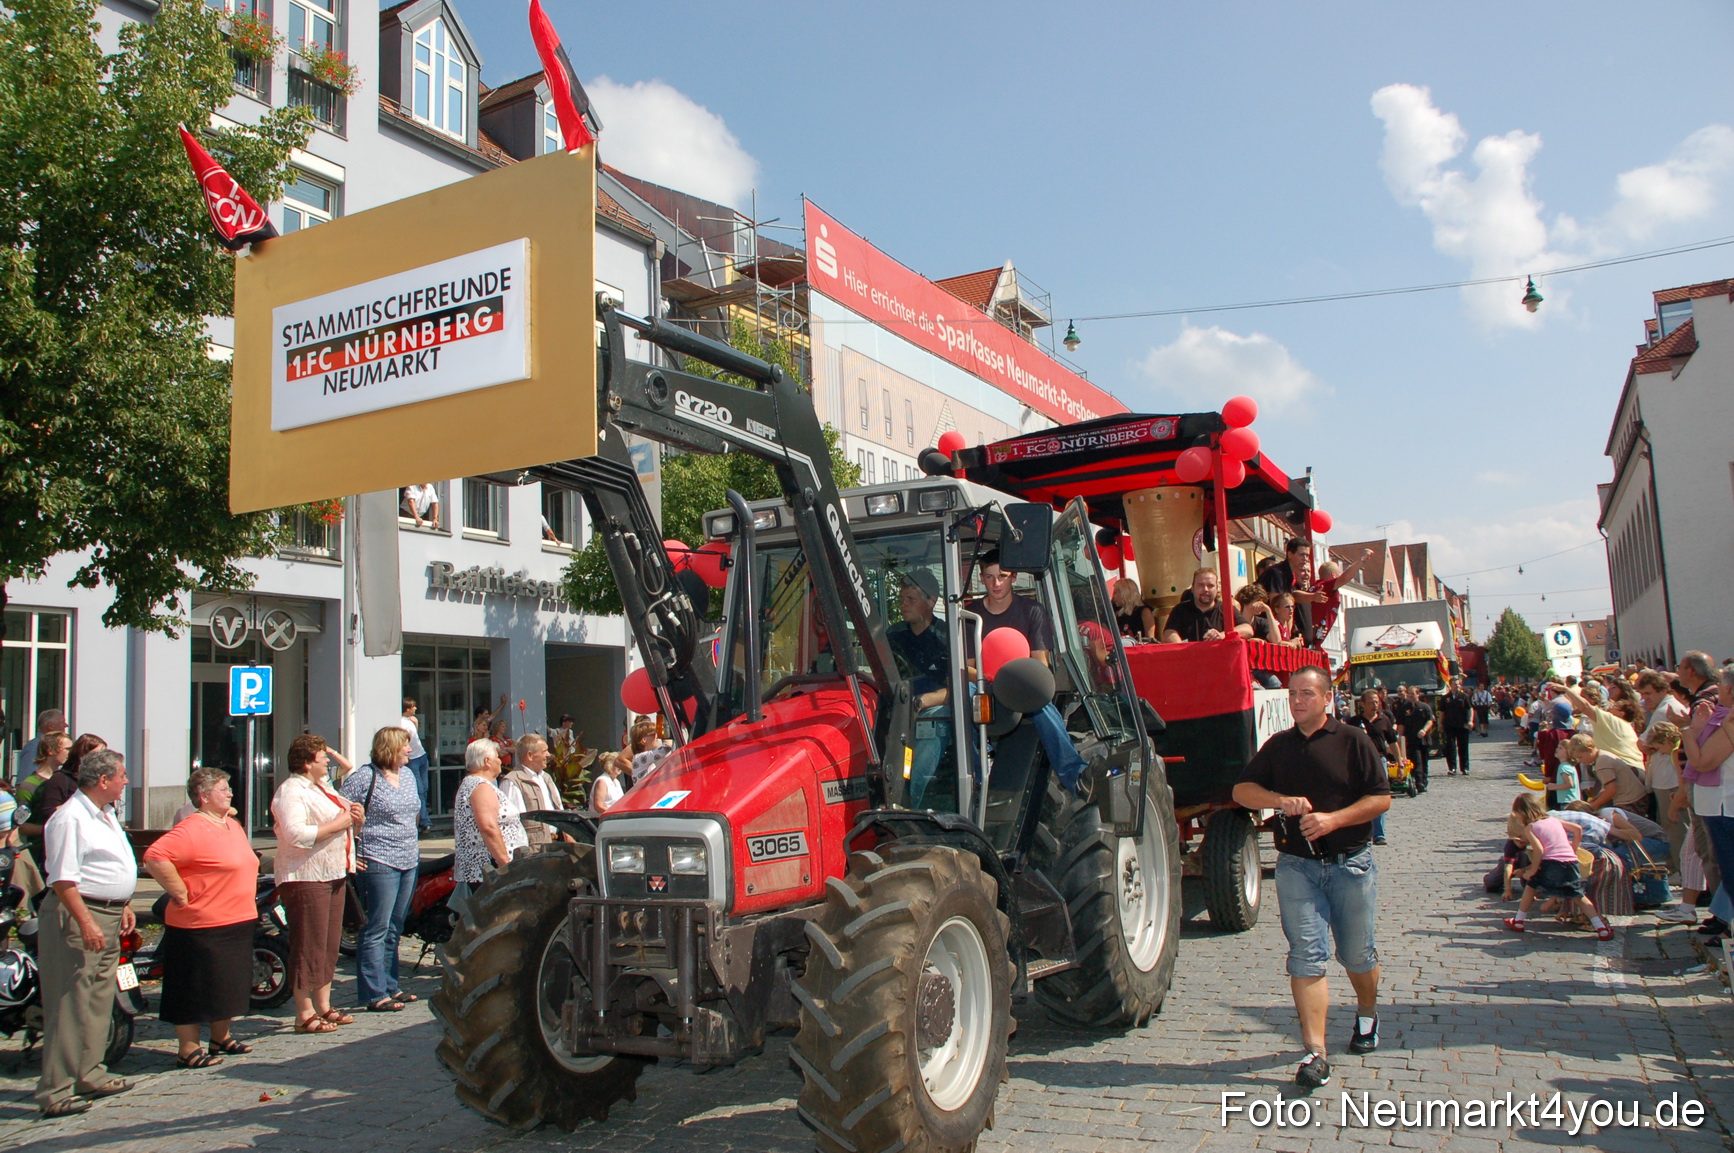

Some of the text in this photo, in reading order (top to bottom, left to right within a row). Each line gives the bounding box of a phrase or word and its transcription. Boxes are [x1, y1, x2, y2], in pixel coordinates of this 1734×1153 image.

[283, 267, 511, 347] STAMMTISCHFREUNDE
[291, 306, 493, 378] 1.FC NÜRNBERG
[843, 266, 1100, 421] Hier errichtet die Sparkasse Neumarkt-Parsber
[323, 347, 441, 396] NEUMARKT
[674, 390, 733, 425] Q720
[1027, 444, 1047, 454] FC
[1061, 428, 1148, 450] NÜRNBERG
[826, 503, 871, 618] Quicke
[430, 560, 571, 600] Raiffeisen
[1556, 647, 1573, 655] ZONE
[240, 672, 262, 709] P
[827, 785, 854, 799] MASSEY
[752, 835, 800, 857] 3065
